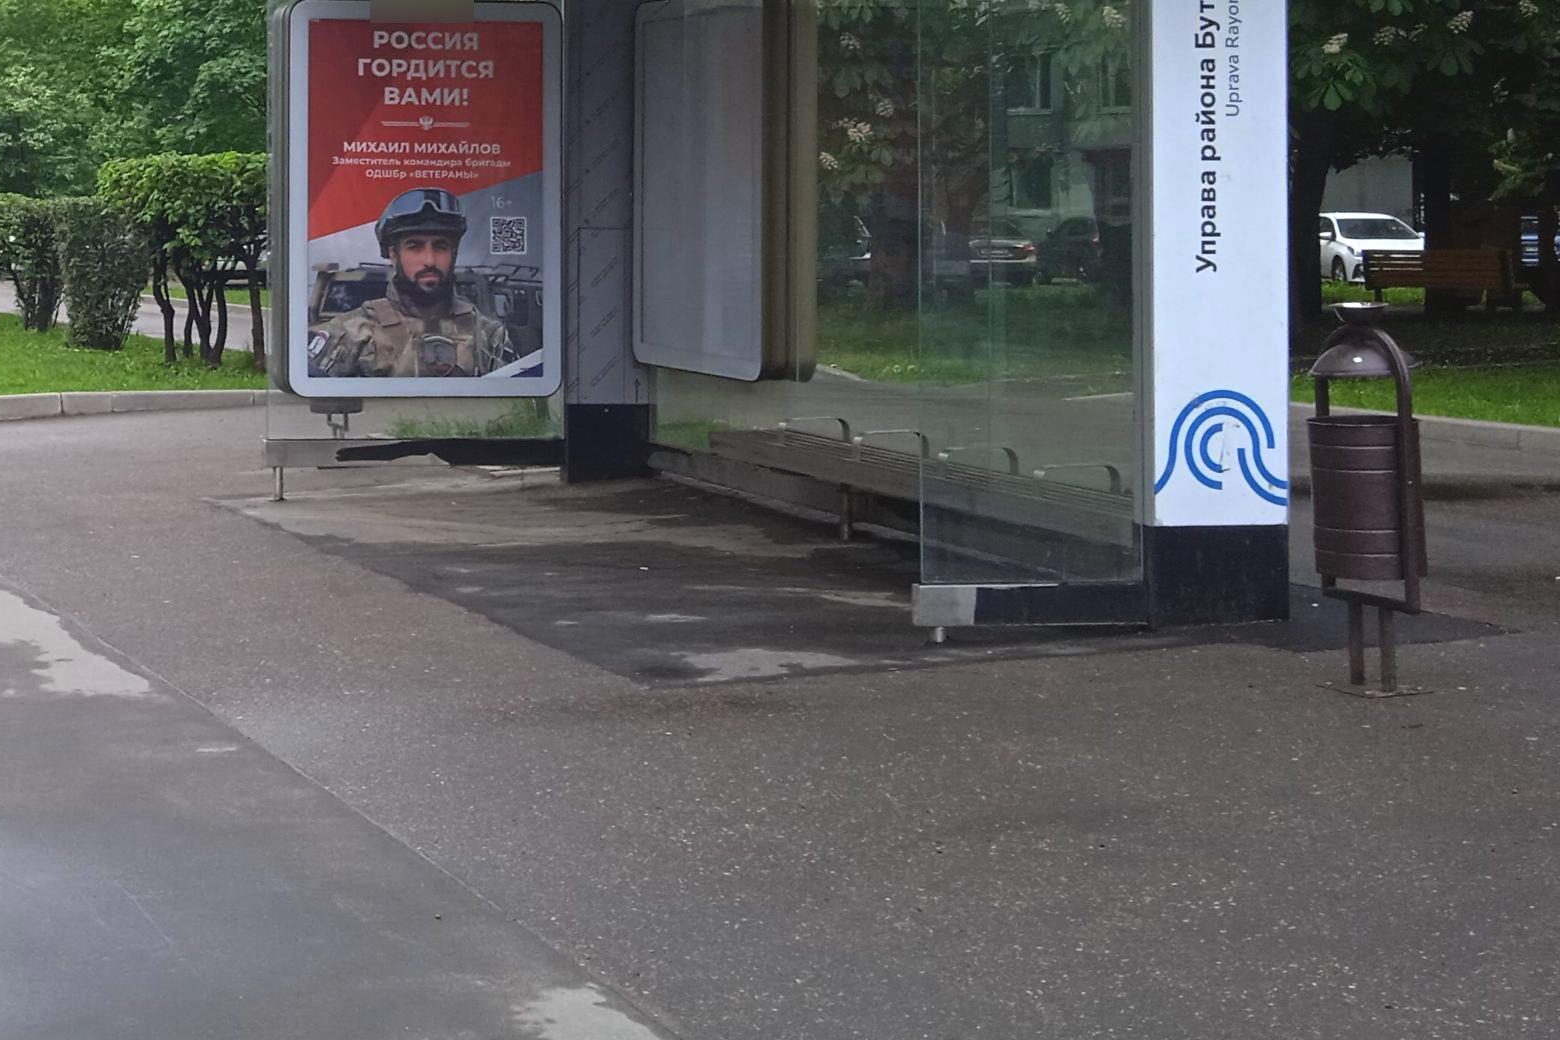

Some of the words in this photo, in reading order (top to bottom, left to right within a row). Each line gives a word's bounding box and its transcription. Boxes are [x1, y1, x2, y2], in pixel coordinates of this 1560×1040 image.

[372, 30, 480, 51] РОССИЯ
[357, 58, 495, 81] ГОРДИТСЯ
[383, 86, 469, 106] ВАМИ!
[1225, 53, 1243, 118] Uprava
[1195, 57, 1221, 161] района
[343, 141, 410, 153] МИХАИЛ
[413, 140, 502, 154] МИХАЙЛОВ
[332, 156, 401, 167] Заместитель
[403, 158, 462, 168] командира
[465, 157, 511, 169] бригады
[365, 169, 407, 180] ОДШБр
[409, 170, 479, 180] «ВЕТЕРАНЫ»
[1195, 170, 1221, 273] Управа
